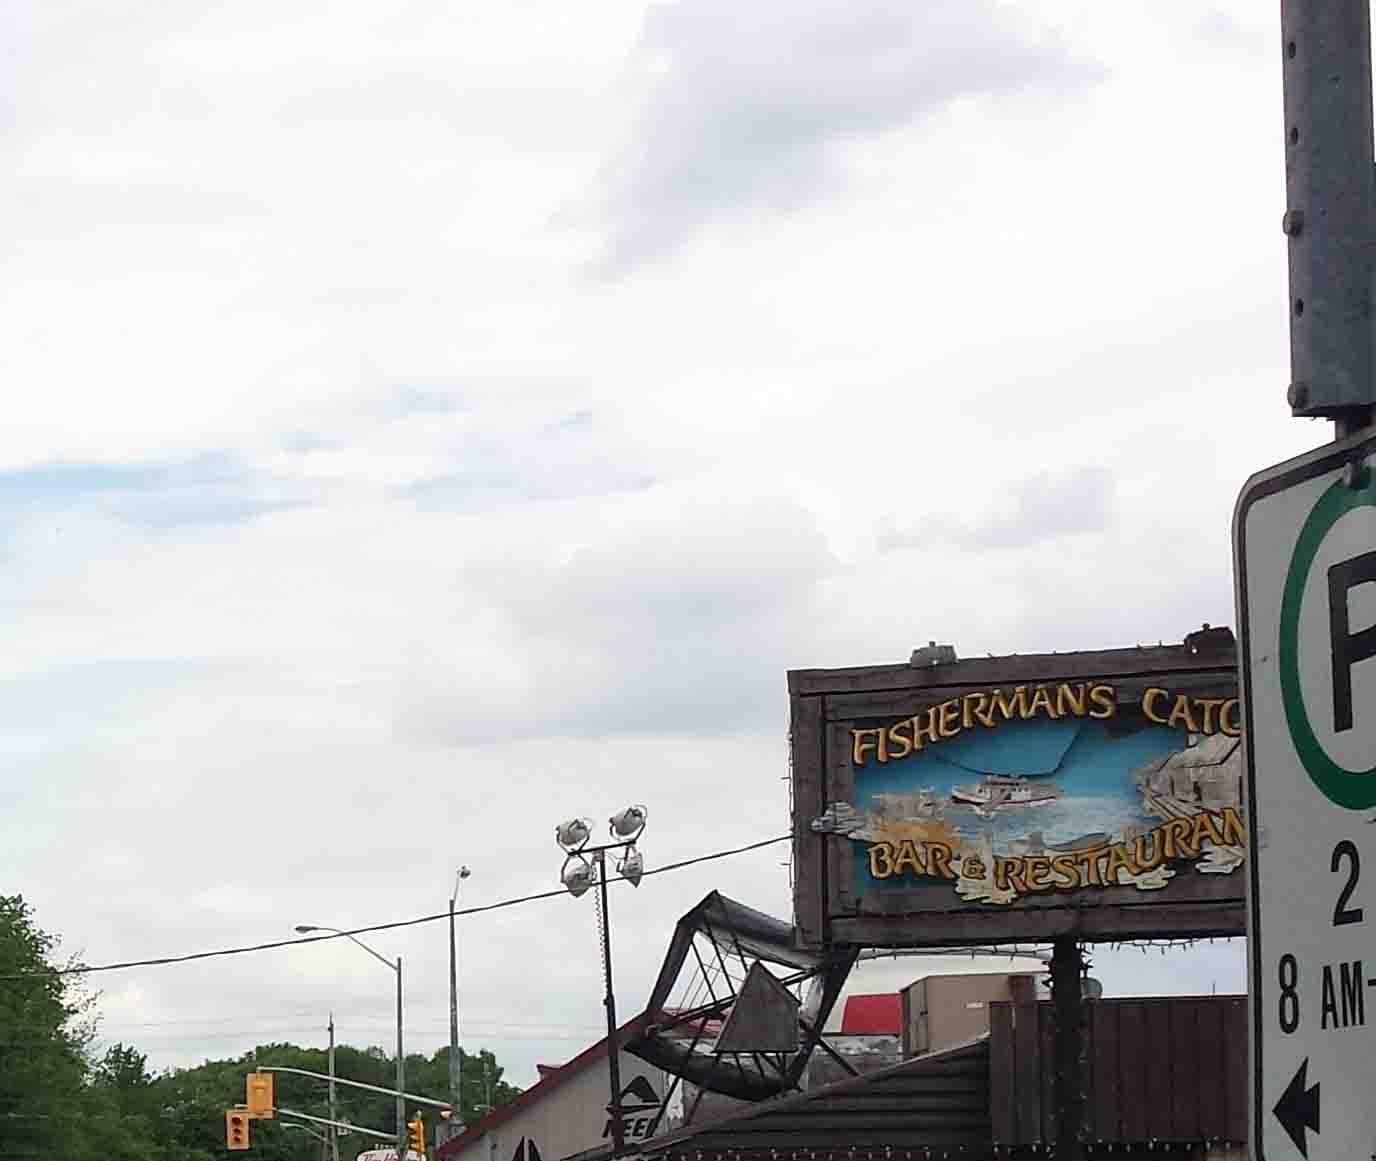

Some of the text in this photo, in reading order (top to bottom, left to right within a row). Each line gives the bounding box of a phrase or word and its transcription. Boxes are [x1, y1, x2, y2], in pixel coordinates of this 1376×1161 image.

[851, 680, 1242, 766] FISHERMAN'S CATC
[869, 806, 1246, 893] BAR & RESTAURAN
[1331, 840, 1363, 927] 2
[1279, 953, 1300, 1035] 8
